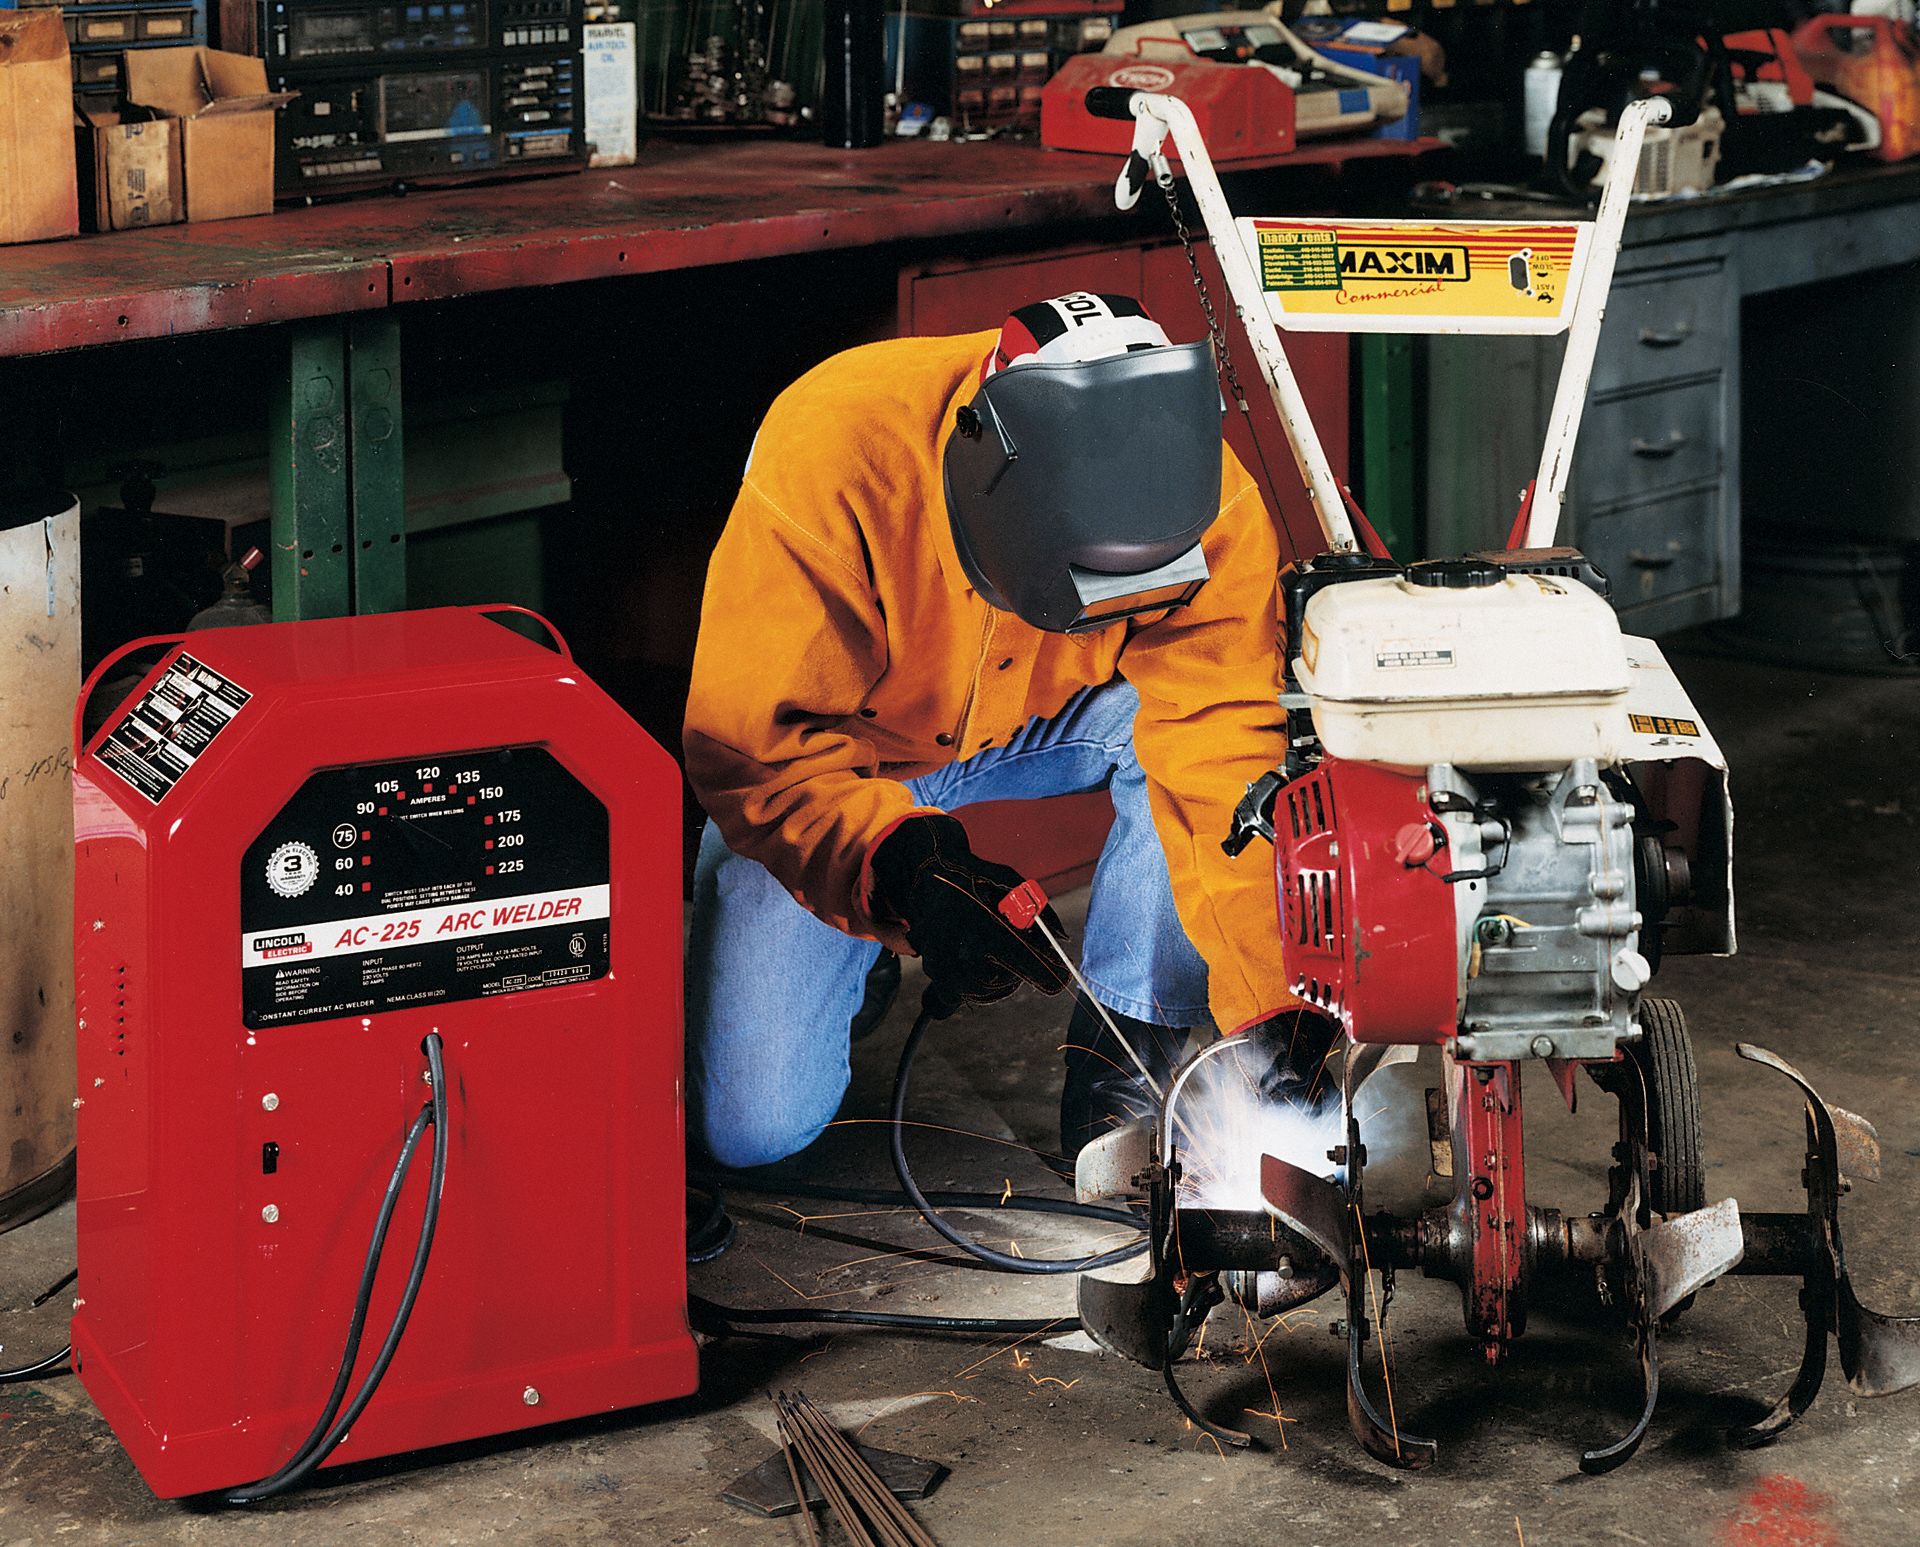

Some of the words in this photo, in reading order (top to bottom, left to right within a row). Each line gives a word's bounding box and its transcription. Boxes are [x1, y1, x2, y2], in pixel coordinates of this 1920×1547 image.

[1264, 233, 1298, 245] handy
[1302, 233, 1331, 243] rents
[1339, 251, 1454, 274] MAXIM
[1336, 277, 1446, 305] Commercial
[416, 766, 440, 780] 120
[455, 770, 481, 784] 135
[374, 780, 399, 794] 105
[479, 786, 503, 800] 150
[410, 795, 446, 806] AMPERES
[356, 802, 375, 815] 90
[497, 809, 521, 823] 175
[336, 830, 353, 842] 75
[497, 834, 524, 848] 200
[284, 855, 302, 872] 3
[335, 857, 353, 870] 60
[498, 860, 524, 874] 225
[335, 884, 353, 897] 40
[334, 919, 422, 949] AC-225
[436, 910, 487, 935] ARC
[492, 897, 582, 927] WELDER
[256, 935, 303, 950] LINCOLN
[456, 943, 484, 954] OUTPUT
[267, 946, 307, 958] ELECTRIC
[362, 957, 383, 966] INPUT
[284, 966, 321, 977] WARNING
[275, 983, 311, 991] INFORMATION
[288, 988, 308, 996] BEFORE
[275, 995, 304, 1003] OPERATING
[386, 995, 405, 1003] NEMA
[406, 991, 426, 1000] CLASS
[298, 1005, 332, 1016] CURRENT
[346, 1000, 374, 1009] WELDER
